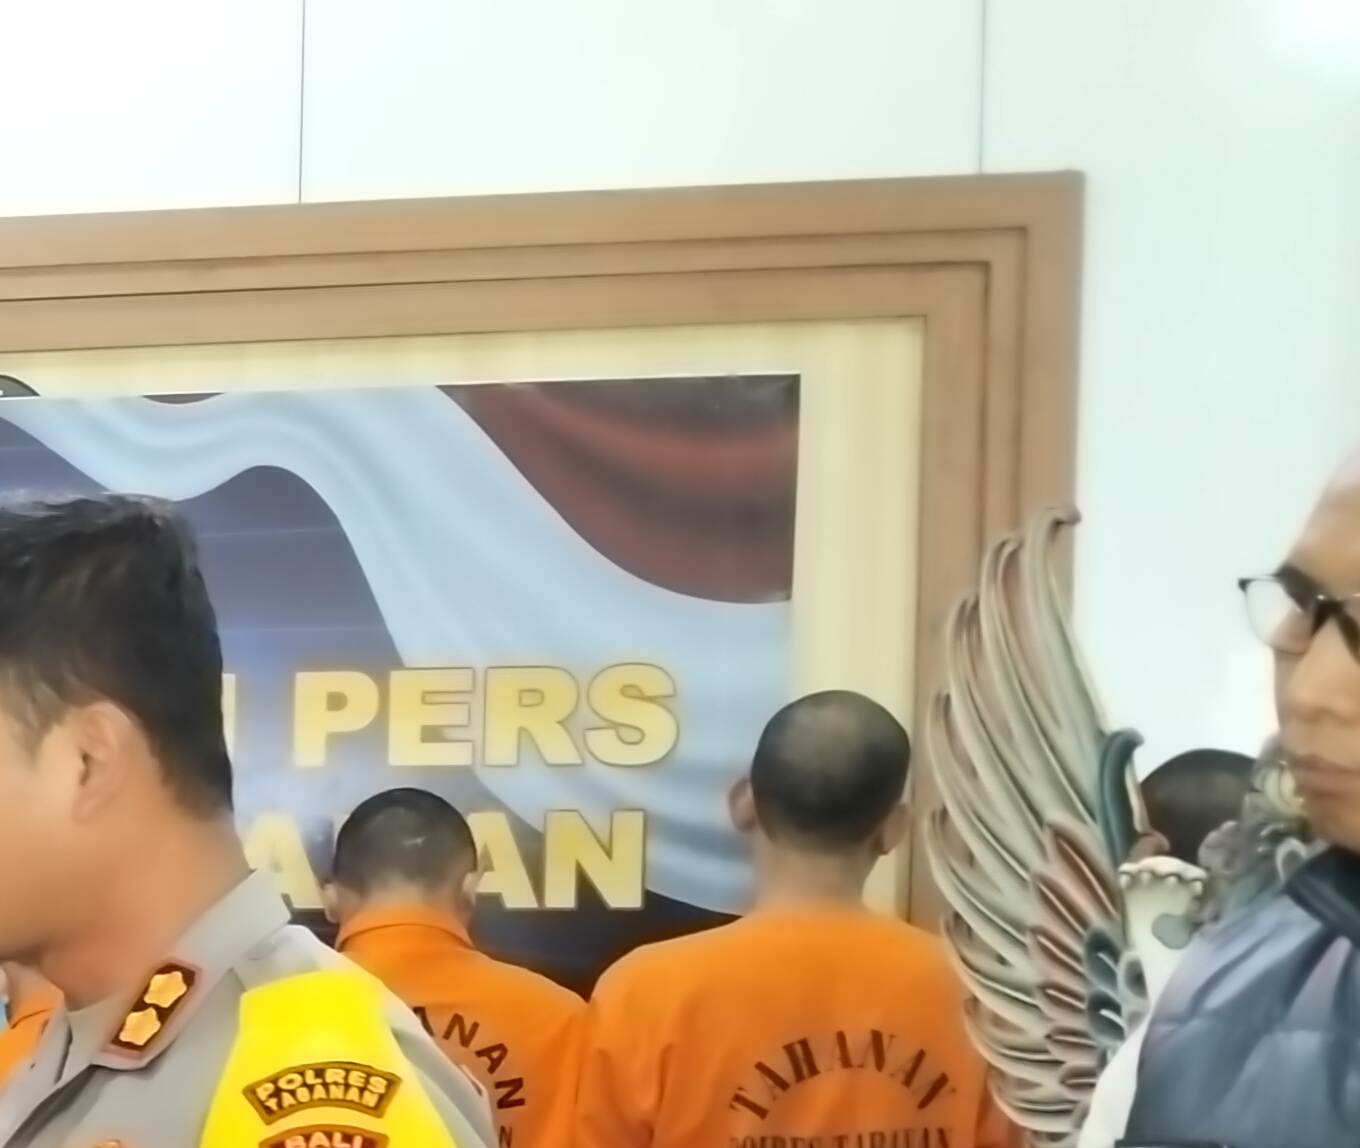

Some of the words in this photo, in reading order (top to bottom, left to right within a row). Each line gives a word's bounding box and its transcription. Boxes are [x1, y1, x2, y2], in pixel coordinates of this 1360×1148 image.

[293, 662, 679, 768] PERS
[255, 1068, 388, 1101] POLRES
[729, 1029, 956, 1120] TAHANAN
